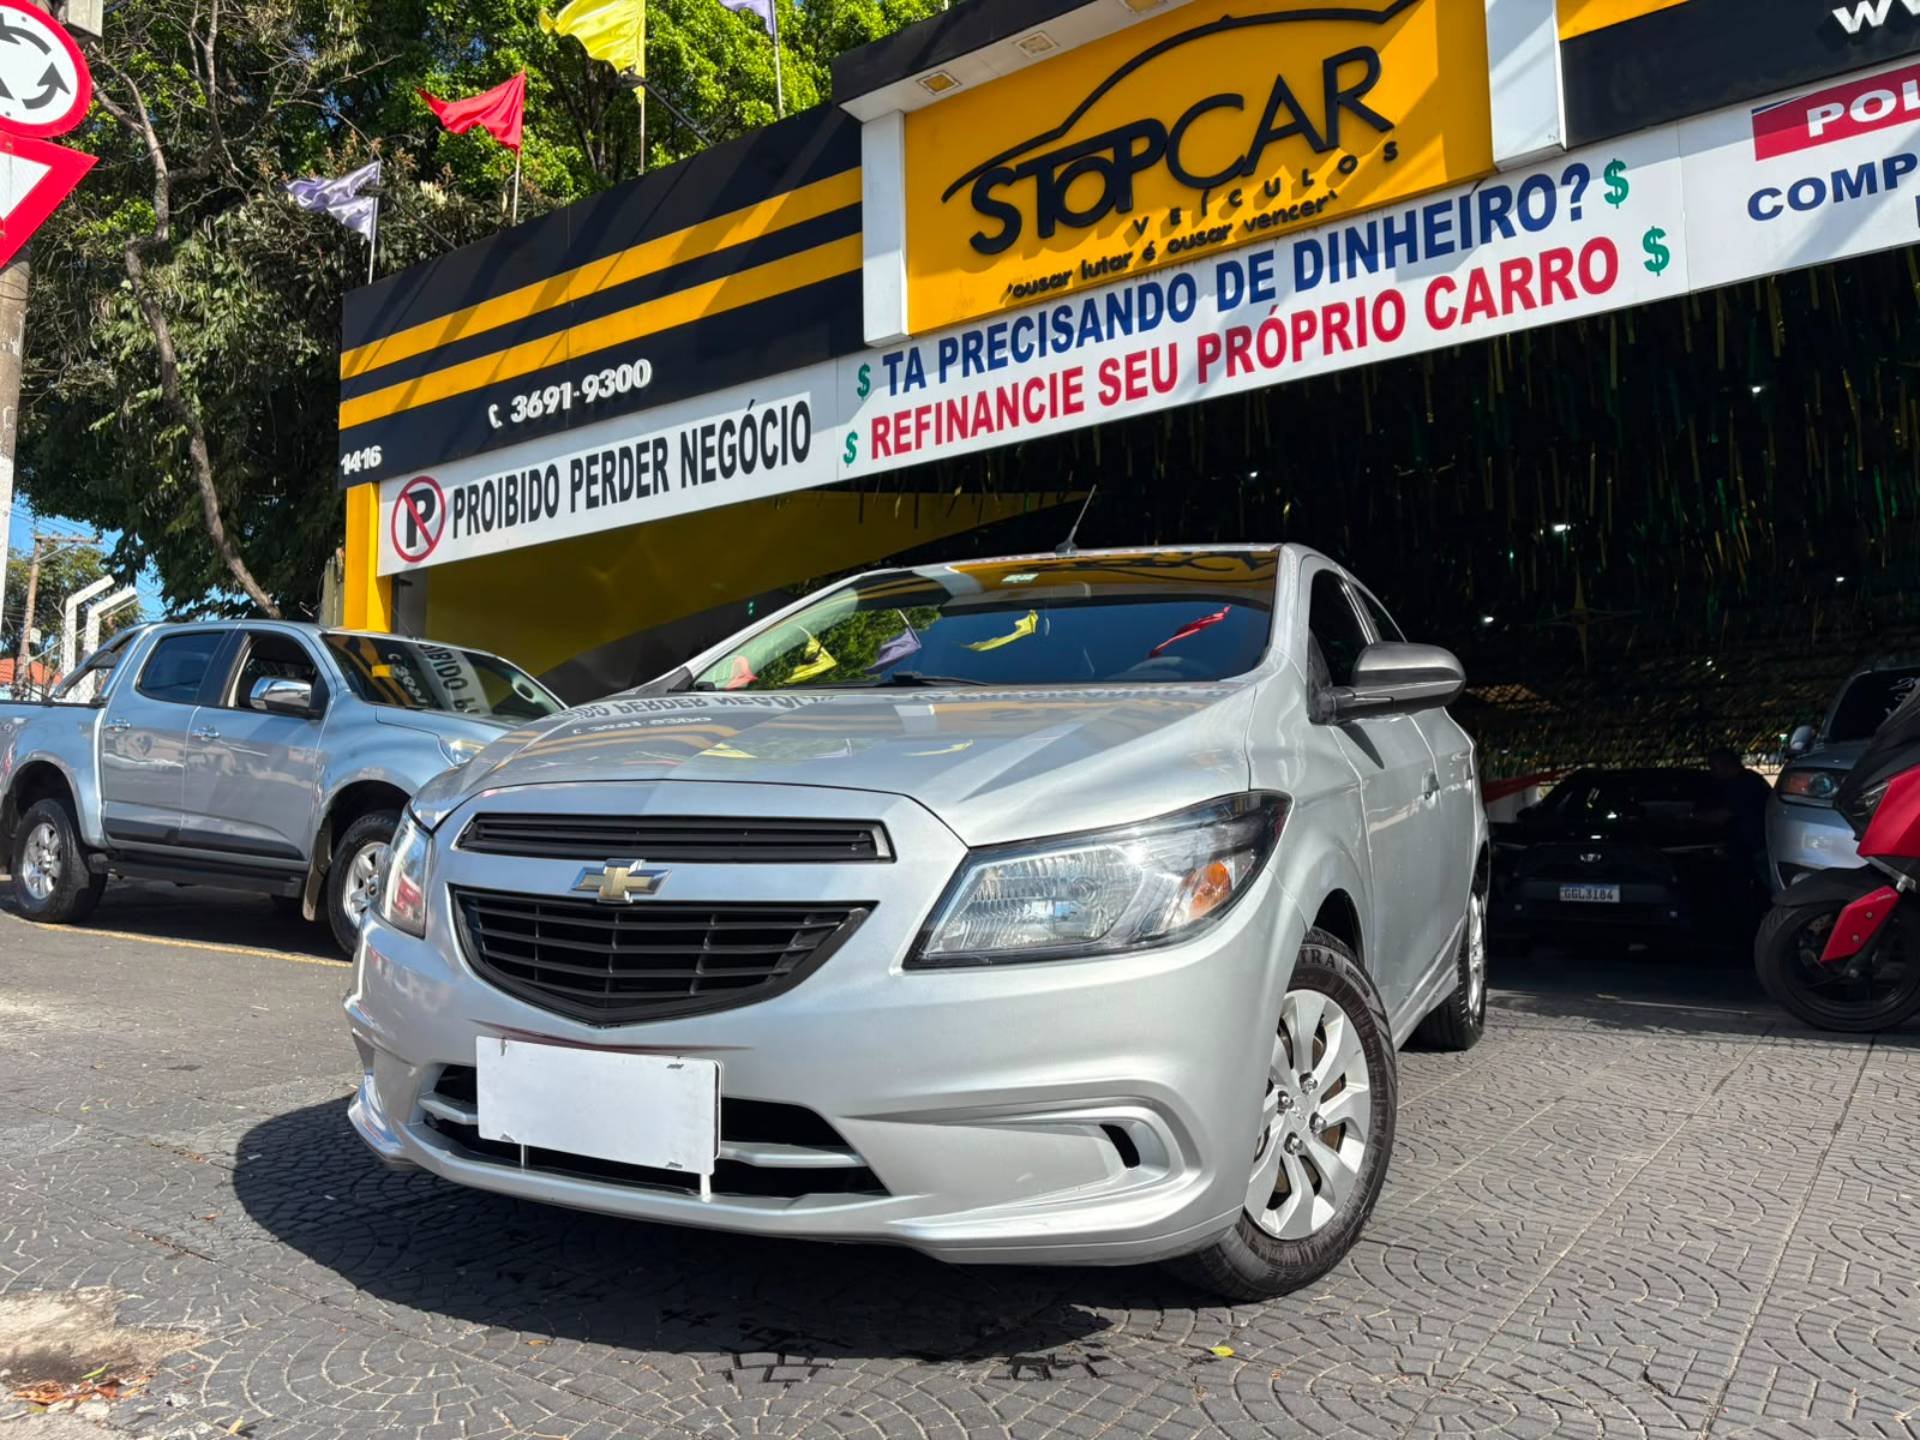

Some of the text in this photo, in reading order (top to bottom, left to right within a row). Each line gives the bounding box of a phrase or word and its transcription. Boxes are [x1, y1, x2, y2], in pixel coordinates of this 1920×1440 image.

[968, 46, 1396, 255] STOPCAR
[1133, 140, 1399, 236] VEÍCULOS
[882, 350, 927, 396] TA
[937, 273, 1198, 384] PRECISANDO
[1216, 248, 1277, 313] DE
[1293, 162, 1591, 293] DINHEIRO?
[1080, 249, 1134, 282] lutar
[1142, 240, 1156, 262] é
[1166, 223, 1233, 254] ousar
[511, 358, 653, 424] 3691-9300
[870, 364, 1085, 460] REFINANCIE
[1097, 342, 1179, 407] SEU
[1196, 288, 1407, 385] PRÓPRIO
[1424, 236, 1619, 331] CARRO
[341, 445, 382, 476] 1416
[453, 399, 811, 539] PROIBIDO PERDER NEGÓCIO
